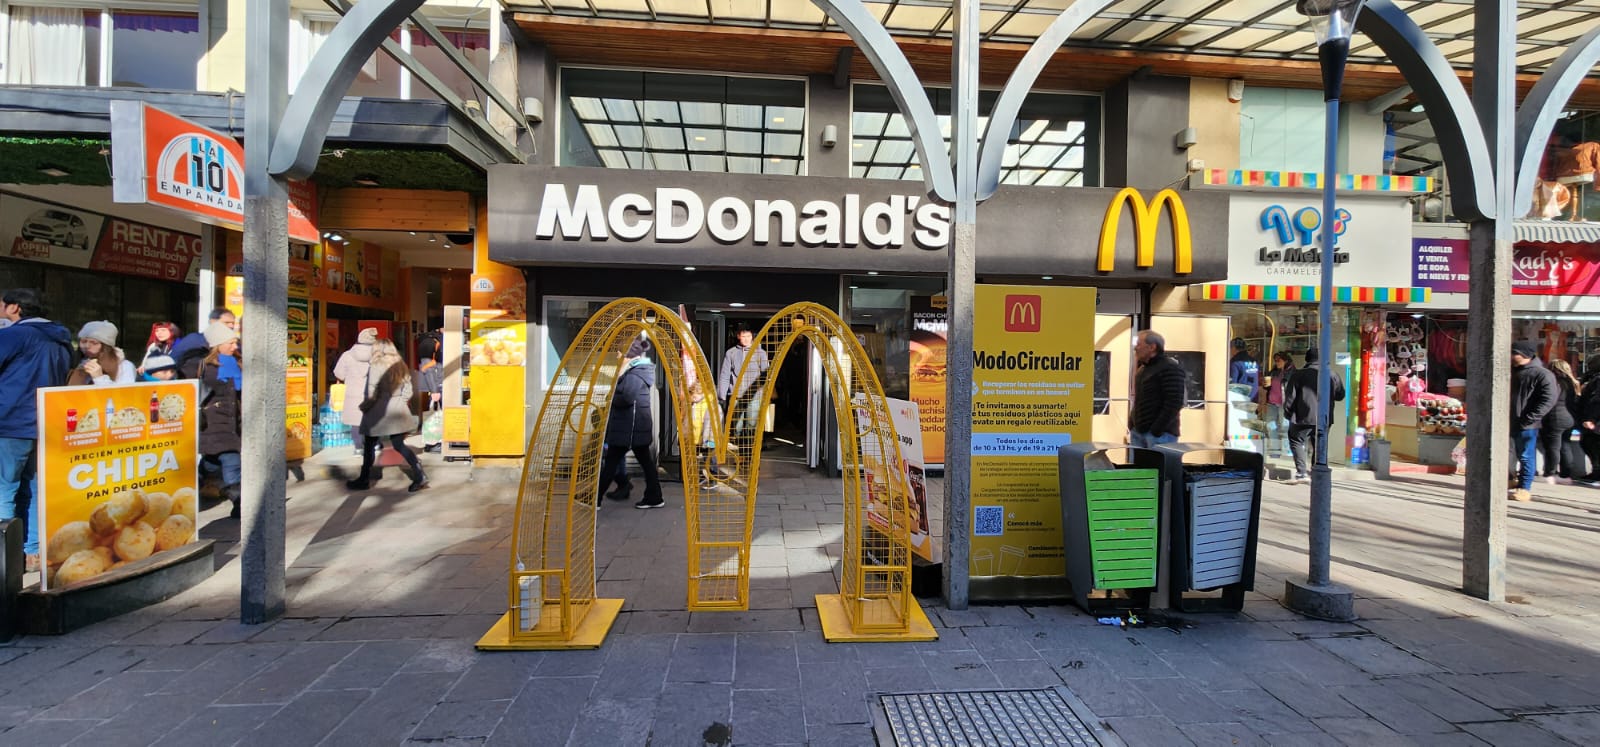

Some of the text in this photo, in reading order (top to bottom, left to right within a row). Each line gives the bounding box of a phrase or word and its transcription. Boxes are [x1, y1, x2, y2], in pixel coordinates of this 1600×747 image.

[199, 143, 216, 158] LA
[193, 155, 224, 192] 10
[161, 181, 243, 210] EMPANADA
[535, 184, 950, 248] McDonald's
[112, 220, 170, 249] RENT
[174, 235, 188, 255] A
[112, 242, 125, 253] #1
[128, 247, 141, 256] en
[1259, 247, 1281, 262] La
[1419, 245, 1453, 254] ALQUILER
[1425, 255, 1449, 263] VENTA
[1429, 264, 1450, 272] ROPA
[1418, 272, 1428, 280] DE
[1429, 273, 1450, 281] NIEVE
[972, 350, 1082, 371] ModoCircular
[1007, 418, 1032, 427] regalo
[1033, 418, 1078, 426] reutilizable.
[118, 440, 179, 454] HORNEADOS!
[902, 435, 912, 446] app
[68, 448, 180, 491] CHIPA
[86, 476, 166, 500] PAN DE QUESO
